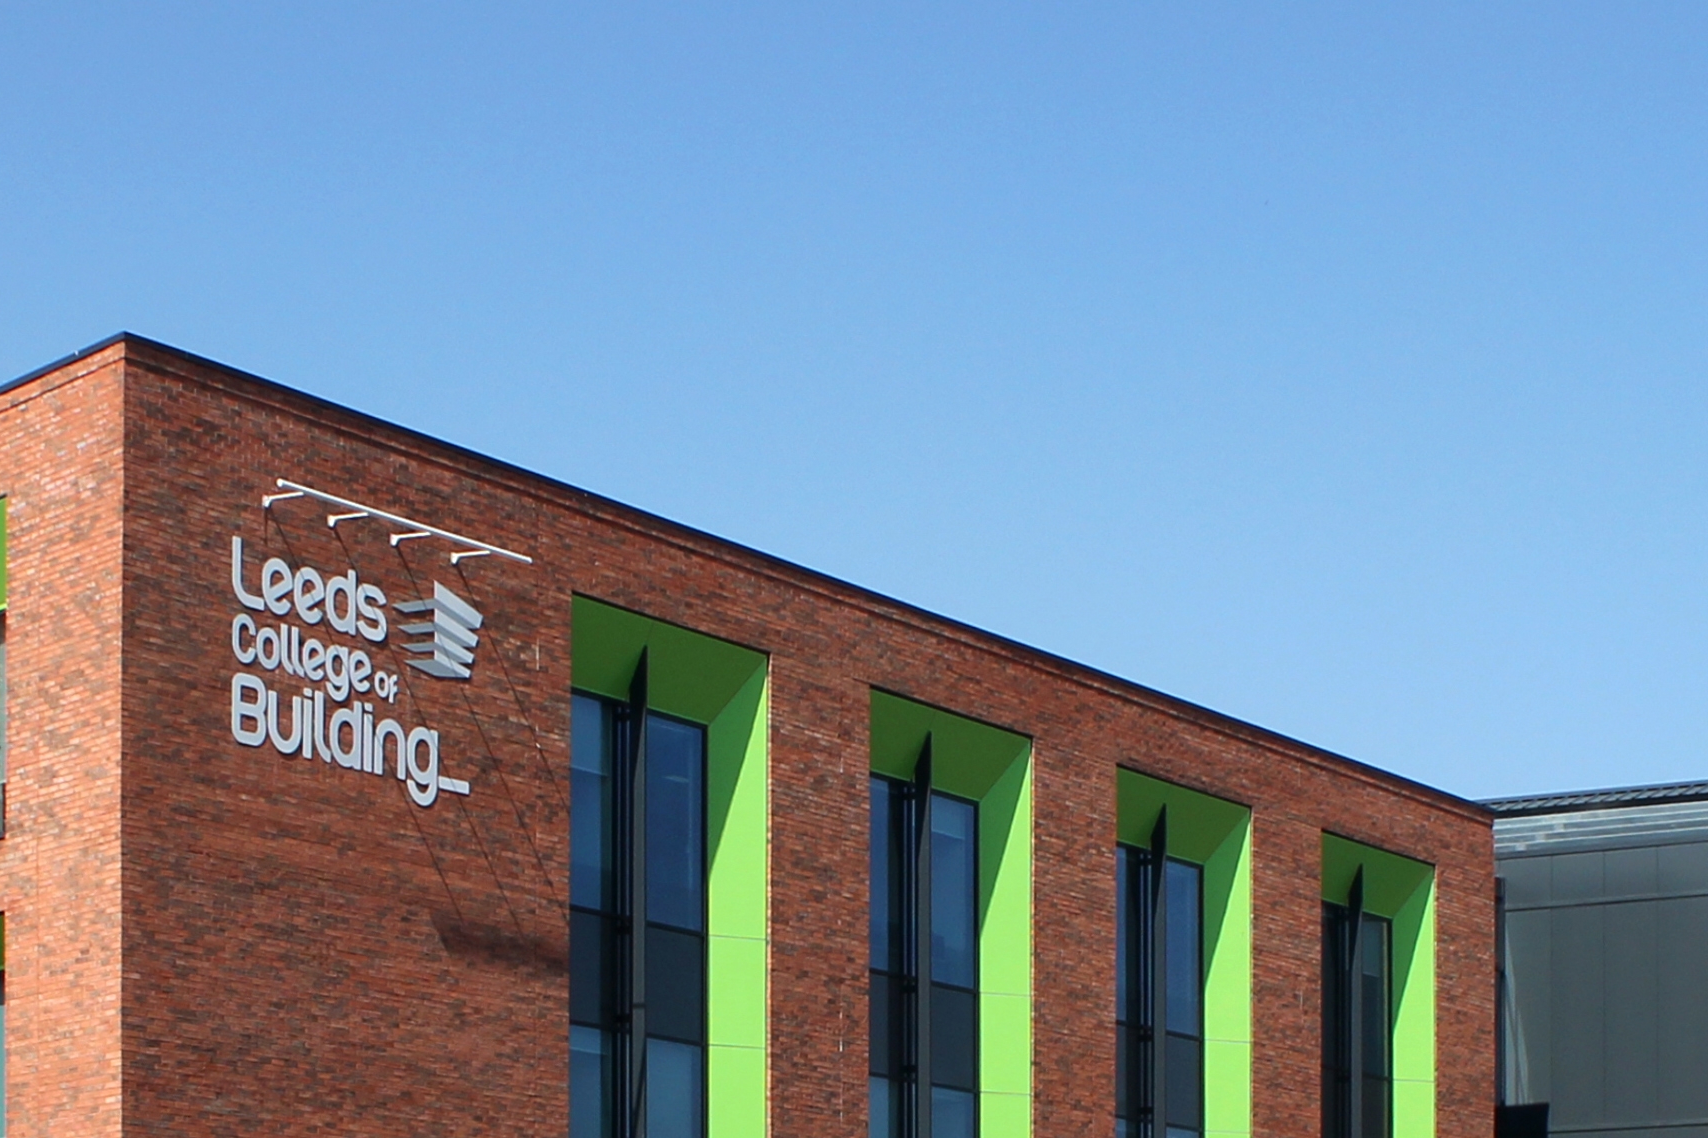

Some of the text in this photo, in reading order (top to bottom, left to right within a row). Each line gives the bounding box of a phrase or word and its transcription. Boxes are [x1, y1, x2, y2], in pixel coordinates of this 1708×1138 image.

[231, 535, 387, 642] Leeds
[231, 613, 398, 703] College of
